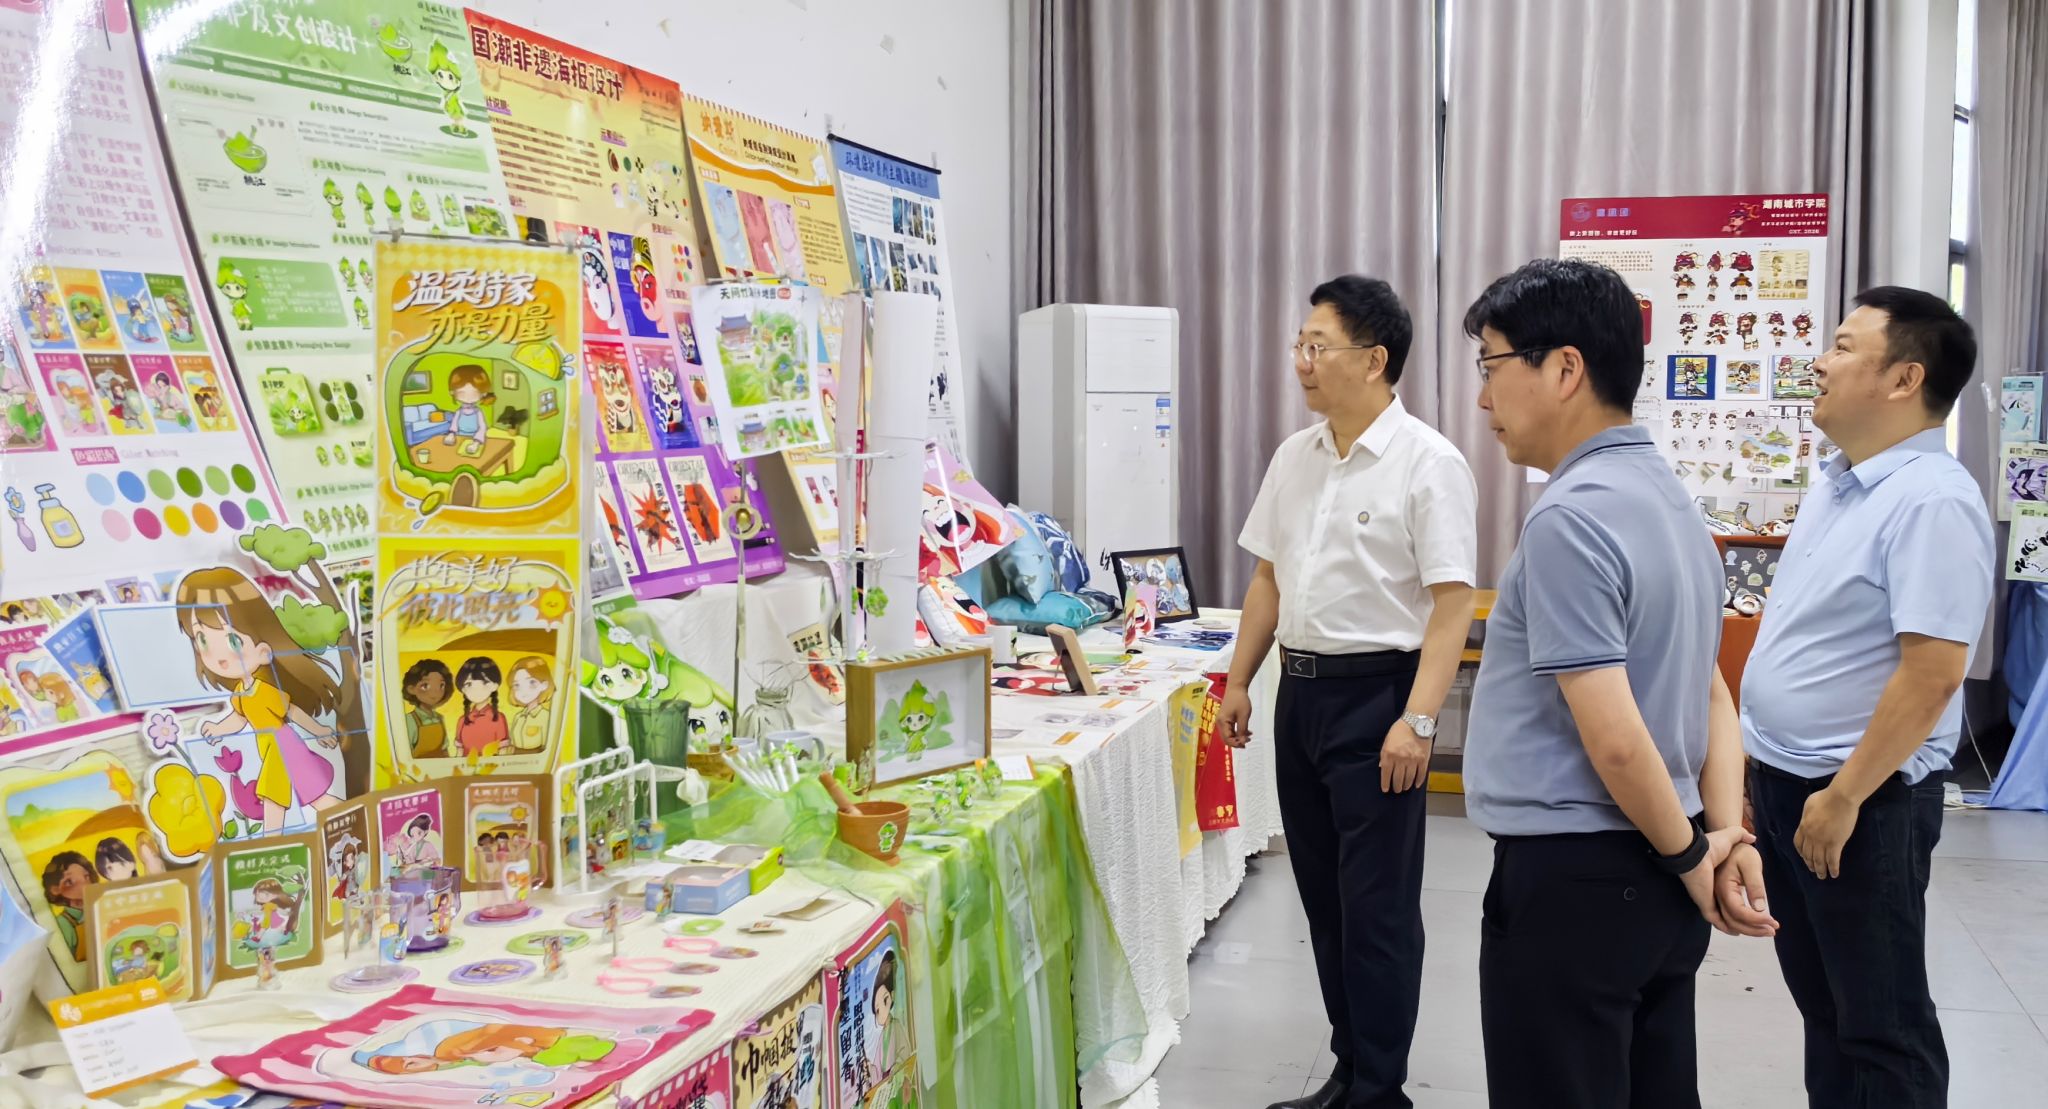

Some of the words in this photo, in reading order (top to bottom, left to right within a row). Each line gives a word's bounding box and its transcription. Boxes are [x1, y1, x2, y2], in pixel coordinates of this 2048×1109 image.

[470, 25, 623, 100] 国潮非遗海报设计
[1762, 198, 1826, 209] 湖南城市学院
[393, 268, 538, 315] 温柔持家
[405, 302, 554, 355] 亦是力量
